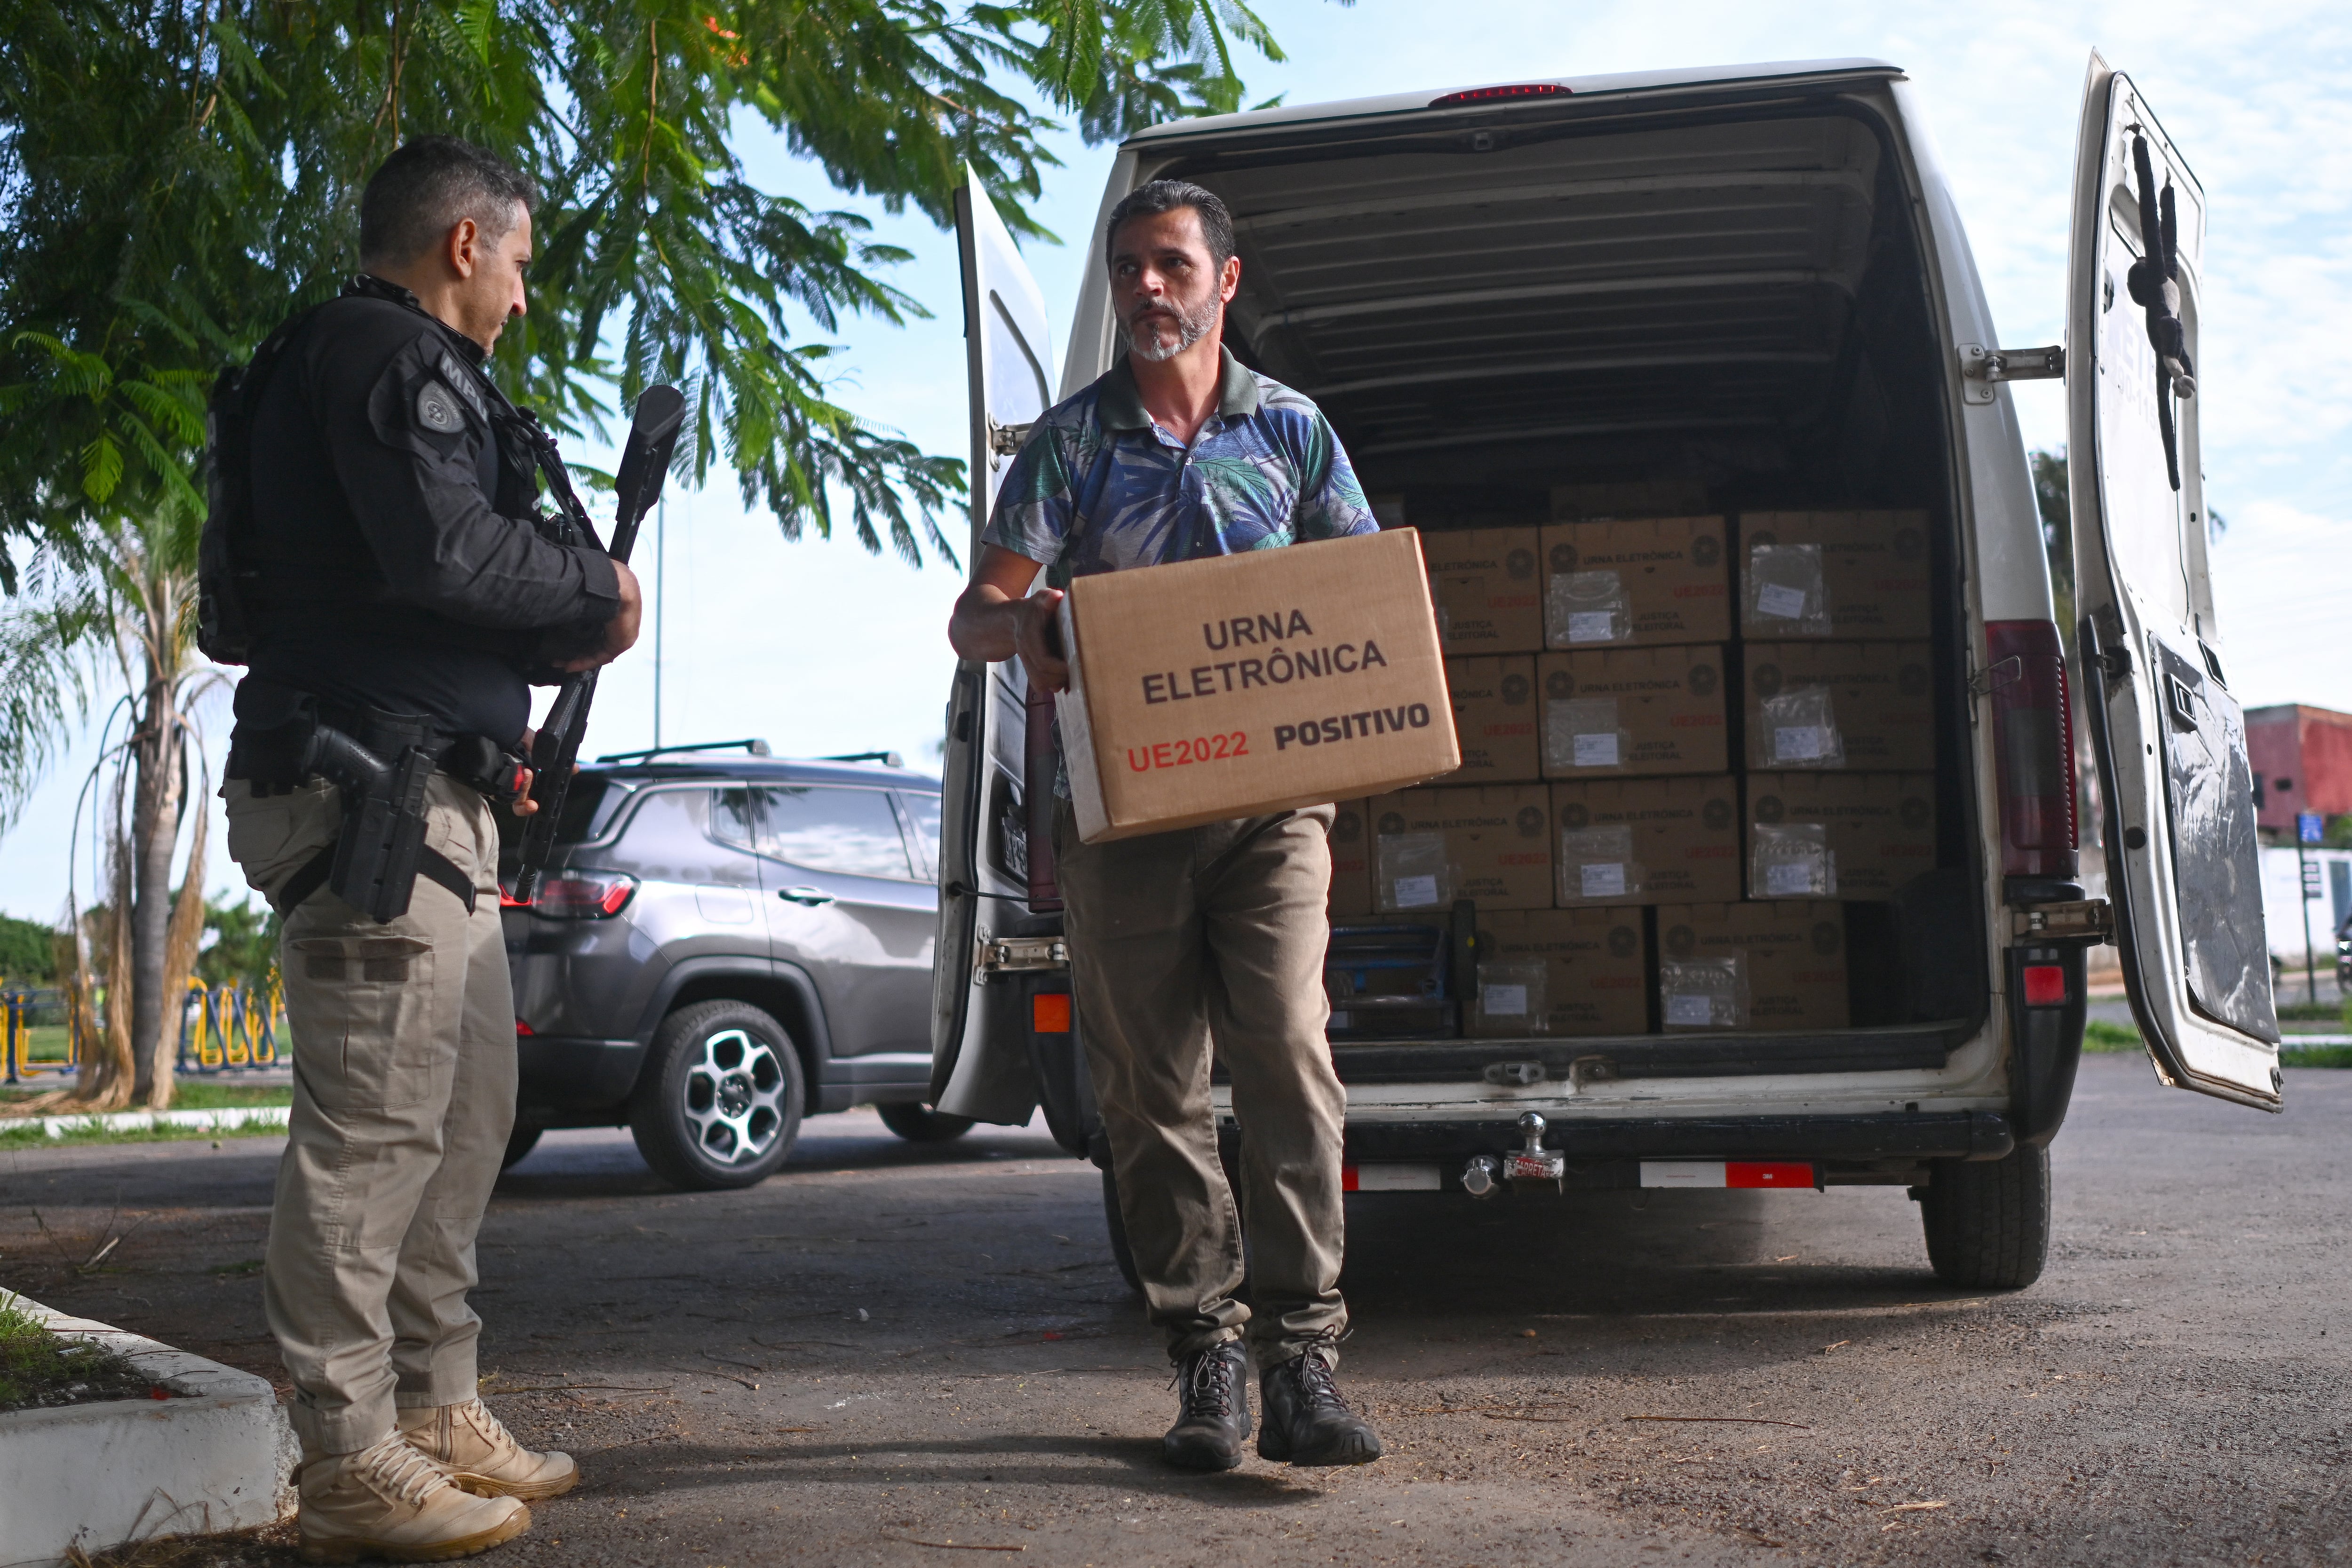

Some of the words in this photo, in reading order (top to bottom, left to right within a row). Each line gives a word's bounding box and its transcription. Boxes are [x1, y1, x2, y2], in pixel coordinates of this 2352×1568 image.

[441, 356, 487, 421] MPU
[1583, 555, 1614, 565] URNA
[1615, 550, 1684, 563] ELETRÔNICA
[1673, 584, 1725, 598] UE2022
[1487, 594, 1537, 609] UE2022
[1638, 612, 1680, 622] JUSTIÇA
[1203, 609, 1313, 652] URNA
[1452, 619, 1493, 630] JUSTIÇA
[1632, 621, 1686, 632] ELEITORAL
[1142, 640, 1387, 705] ELETRÔNICA
[1580, 683, 1610, 693] URNA
[1613, 680, 1680, 691] ELETRÔNICA
[1670, 714, 1723, 728] UE2022
[1127, 731, 1249, 772] UE2022
[1274, 703, 1430, 751] POSITIVO
[1635, 741, 1676, 751] JUSTIÇA
[1629, 752, 1682, 761] ELEITORAL
[1594, 812, 1623, 822] URNA
[1627, 808, 1693, 820] ELETRÔNICA
[1411, 821, 1439, 830] URNA
[1442, 816, 1508, 828] ELETRÔNICA
[1334, 860, 1364, 871] 2022
[1498, 853, 1548, 866] UE2022
[1464, 878, 1503, 888] JUSTIÇA
